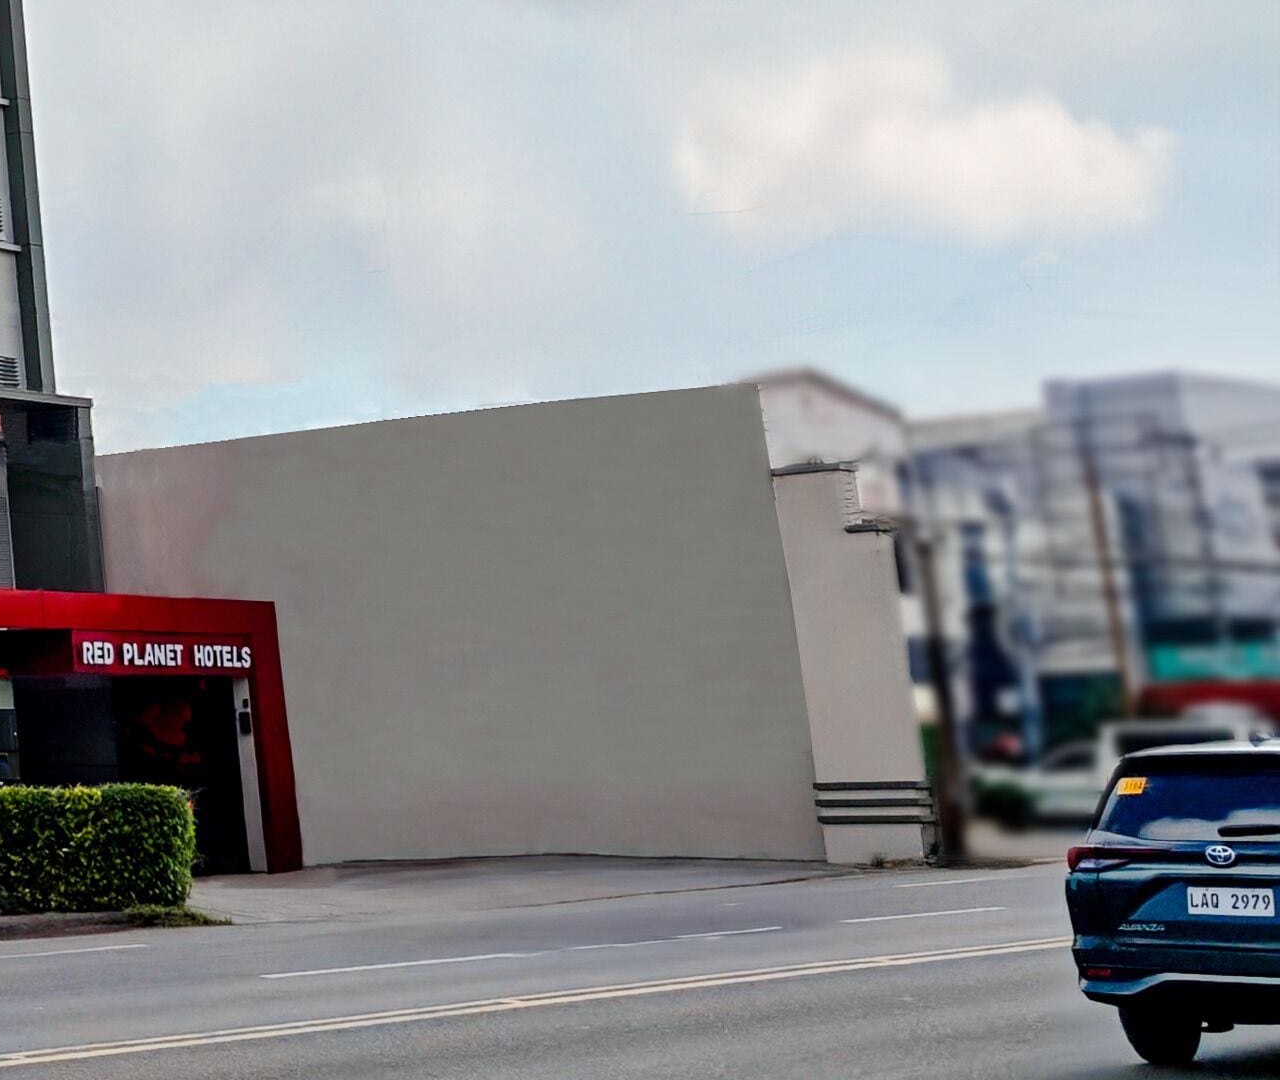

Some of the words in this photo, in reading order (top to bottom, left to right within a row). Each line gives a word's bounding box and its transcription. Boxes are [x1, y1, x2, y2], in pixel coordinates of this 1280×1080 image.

[82, 641, 114, 665] RED
[122, 642, 184, 666] PLANET
[193, 644, 252, 669] HOTELS
[1190, 892, 1219, 909] LAQ
[1231, 893, 1271, 911] 2979
